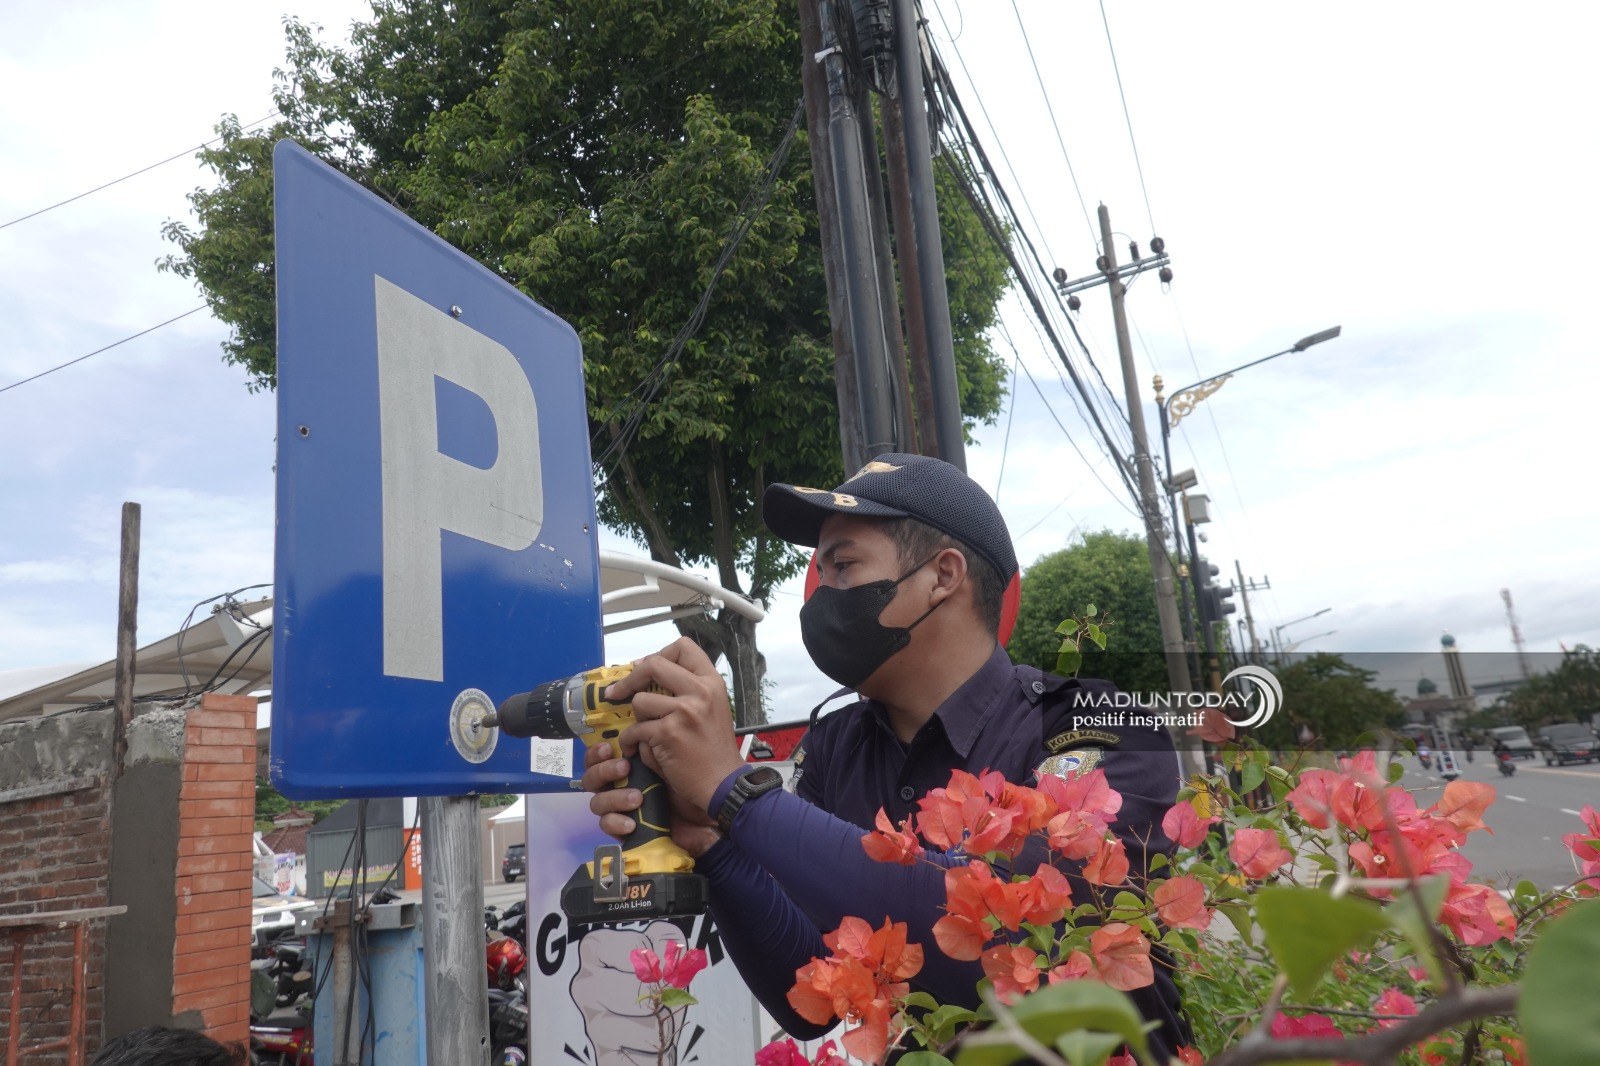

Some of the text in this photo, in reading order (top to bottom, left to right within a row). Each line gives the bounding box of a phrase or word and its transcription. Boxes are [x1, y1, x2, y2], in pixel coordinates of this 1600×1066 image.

[374, 273, 543, 682] P
[1050, 731, 1117, 748] KOTA MADIUN
[608, 900, 652, 911] 2.0Ah Li-ion
